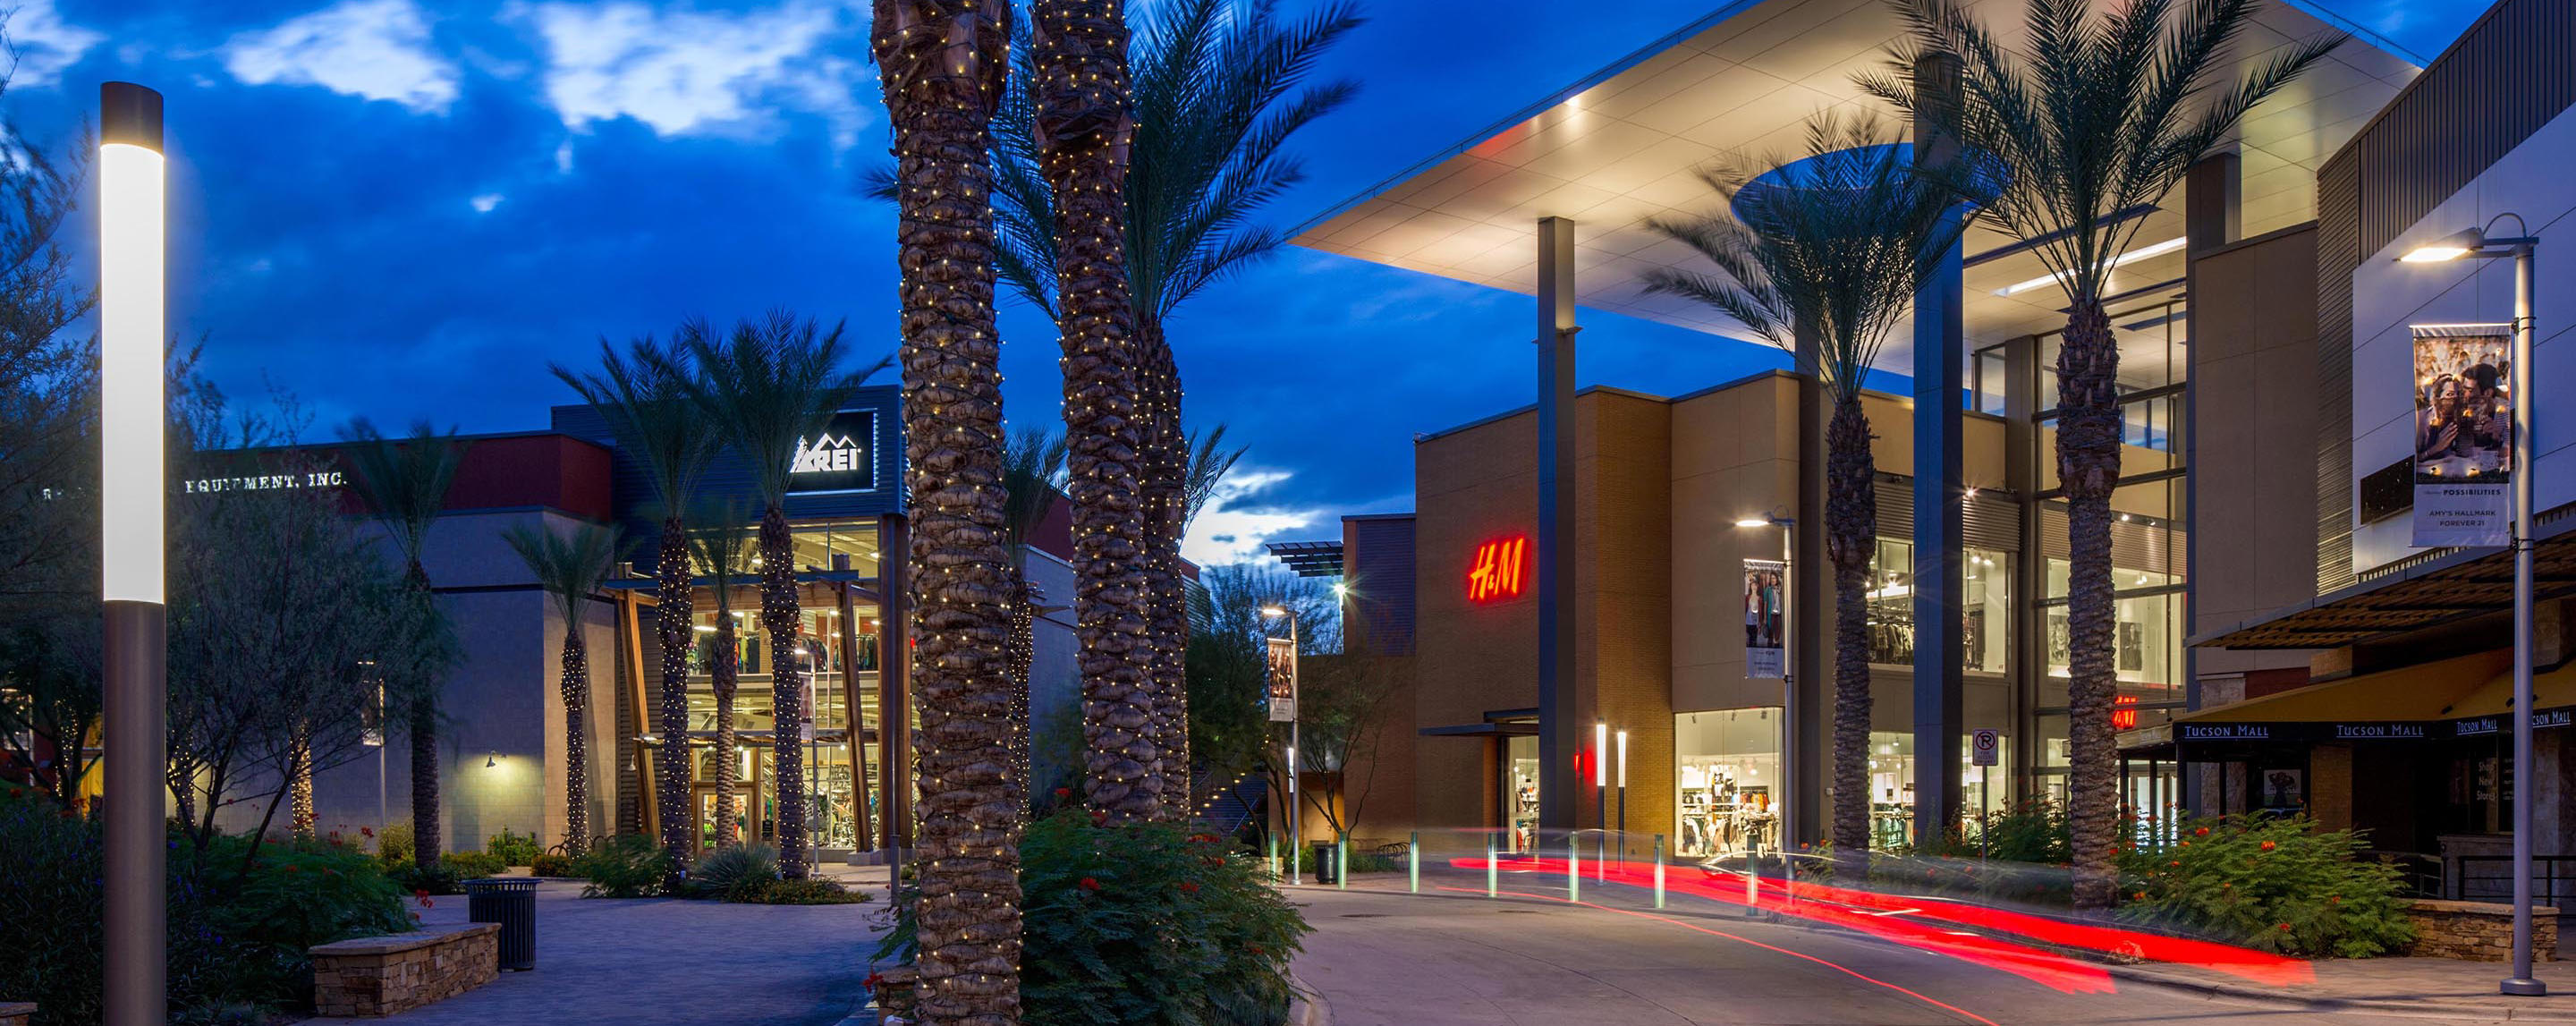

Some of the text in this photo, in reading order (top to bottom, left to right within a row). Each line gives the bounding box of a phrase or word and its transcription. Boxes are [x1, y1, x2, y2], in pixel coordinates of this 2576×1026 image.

[811, 448, 857, 471] REI
[308, 471, 347, 487] INC.
[1470, 538, 1524, 599] H&M
[2481, 718, 2497, 730] MALL
[2552, 711, 2571, 724] MALL
[2184, 725, 2269, 737] TUCSON MALL
[2336, 724, 2424, 736] TUCSON MALL
